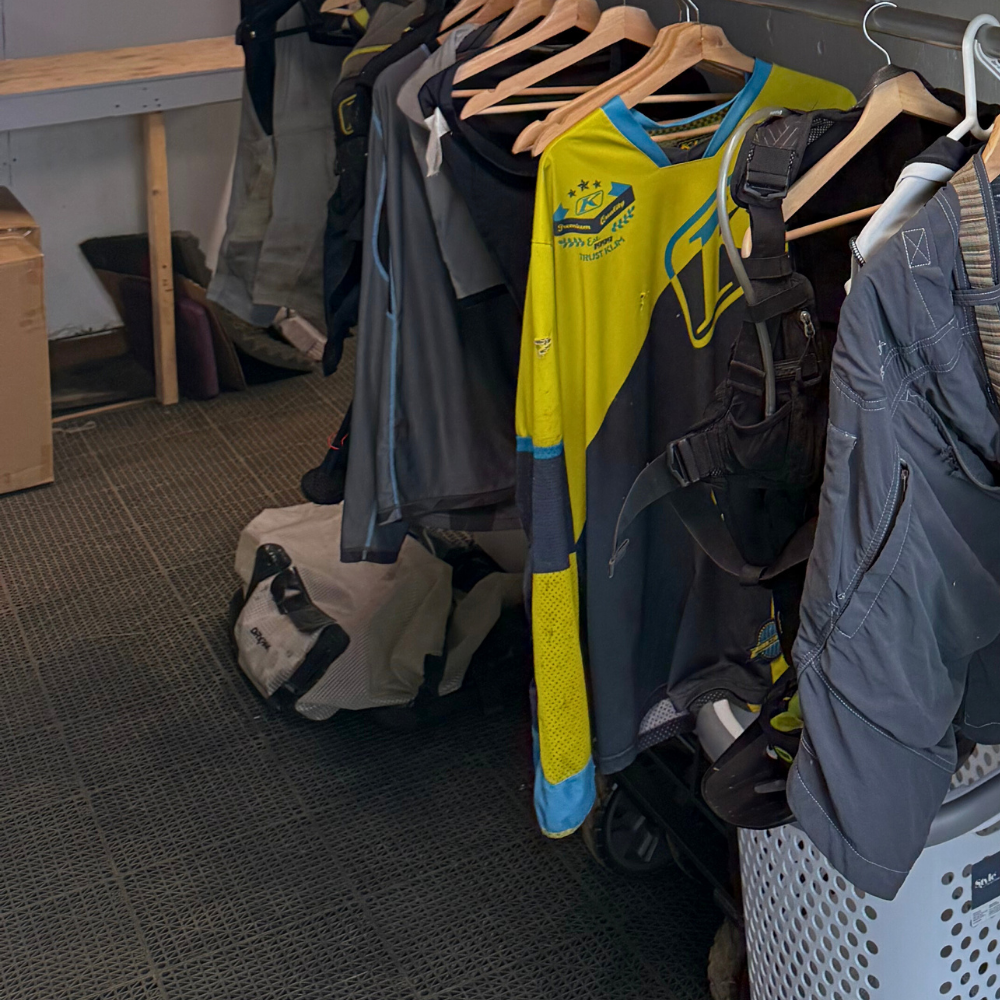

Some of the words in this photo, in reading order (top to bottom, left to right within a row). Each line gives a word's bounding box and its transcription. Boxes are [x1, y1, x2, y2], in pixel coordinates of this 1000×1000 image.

[600, 200, 625, 225] Quality
[558, 224, 591, 232] Premium
[579, 250, 603, 261] TRUST
[604, 237, 625, 254] KLIM
